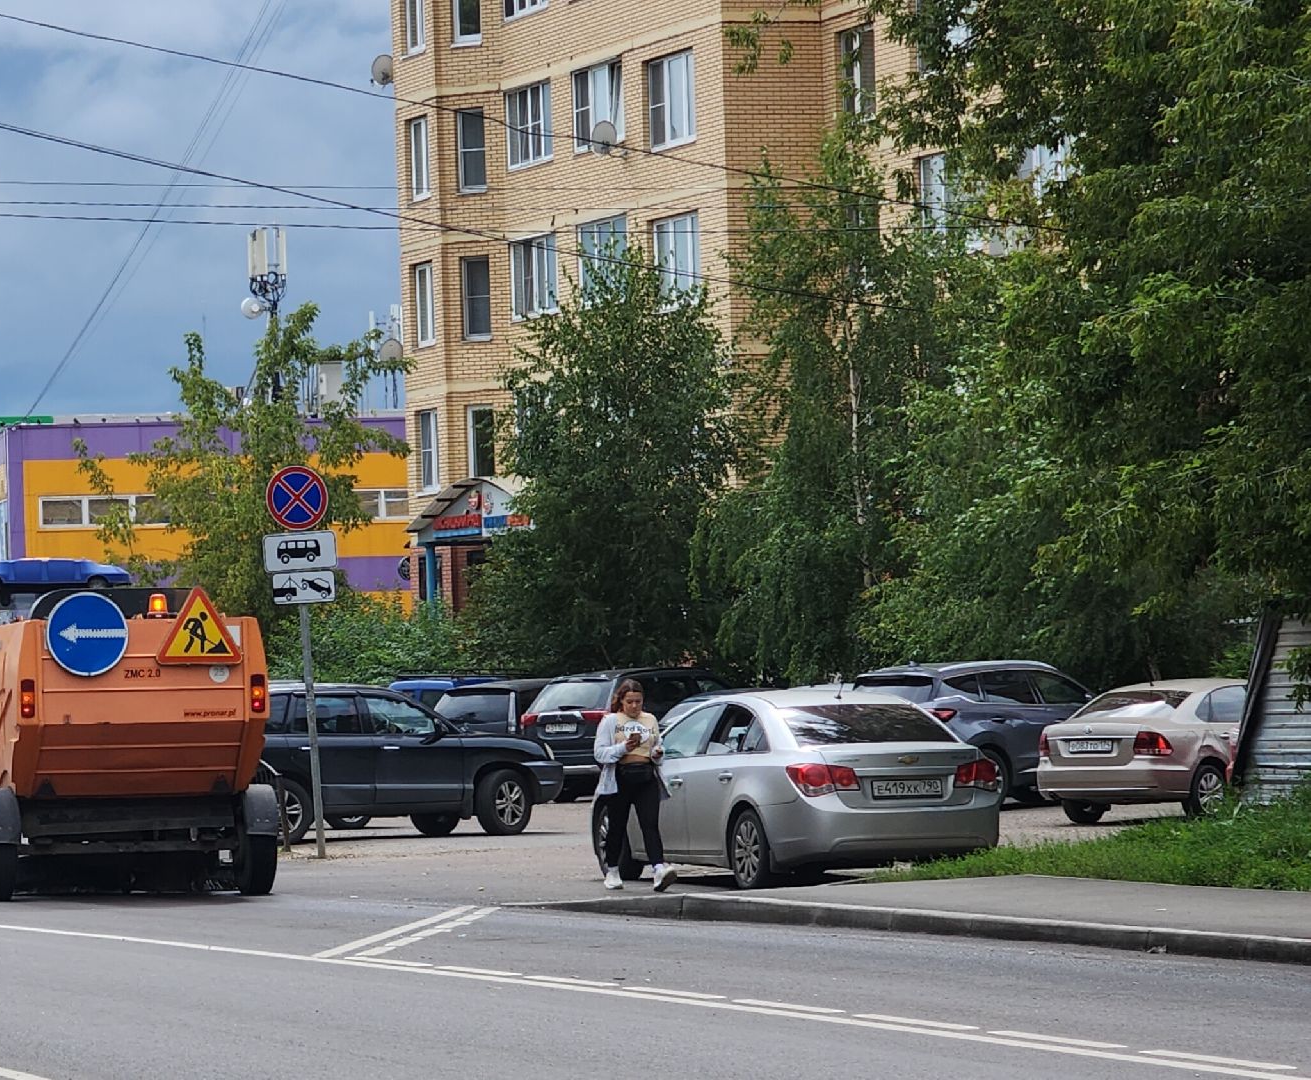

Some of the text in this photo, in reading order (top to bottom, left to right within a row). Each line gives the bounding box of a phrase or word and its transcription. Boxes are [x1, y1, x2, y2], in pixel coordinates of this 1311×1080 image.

[124, 669, 161, 679] ZMC 2.0
[183, 708, 237, 718] www.pronar.pl
